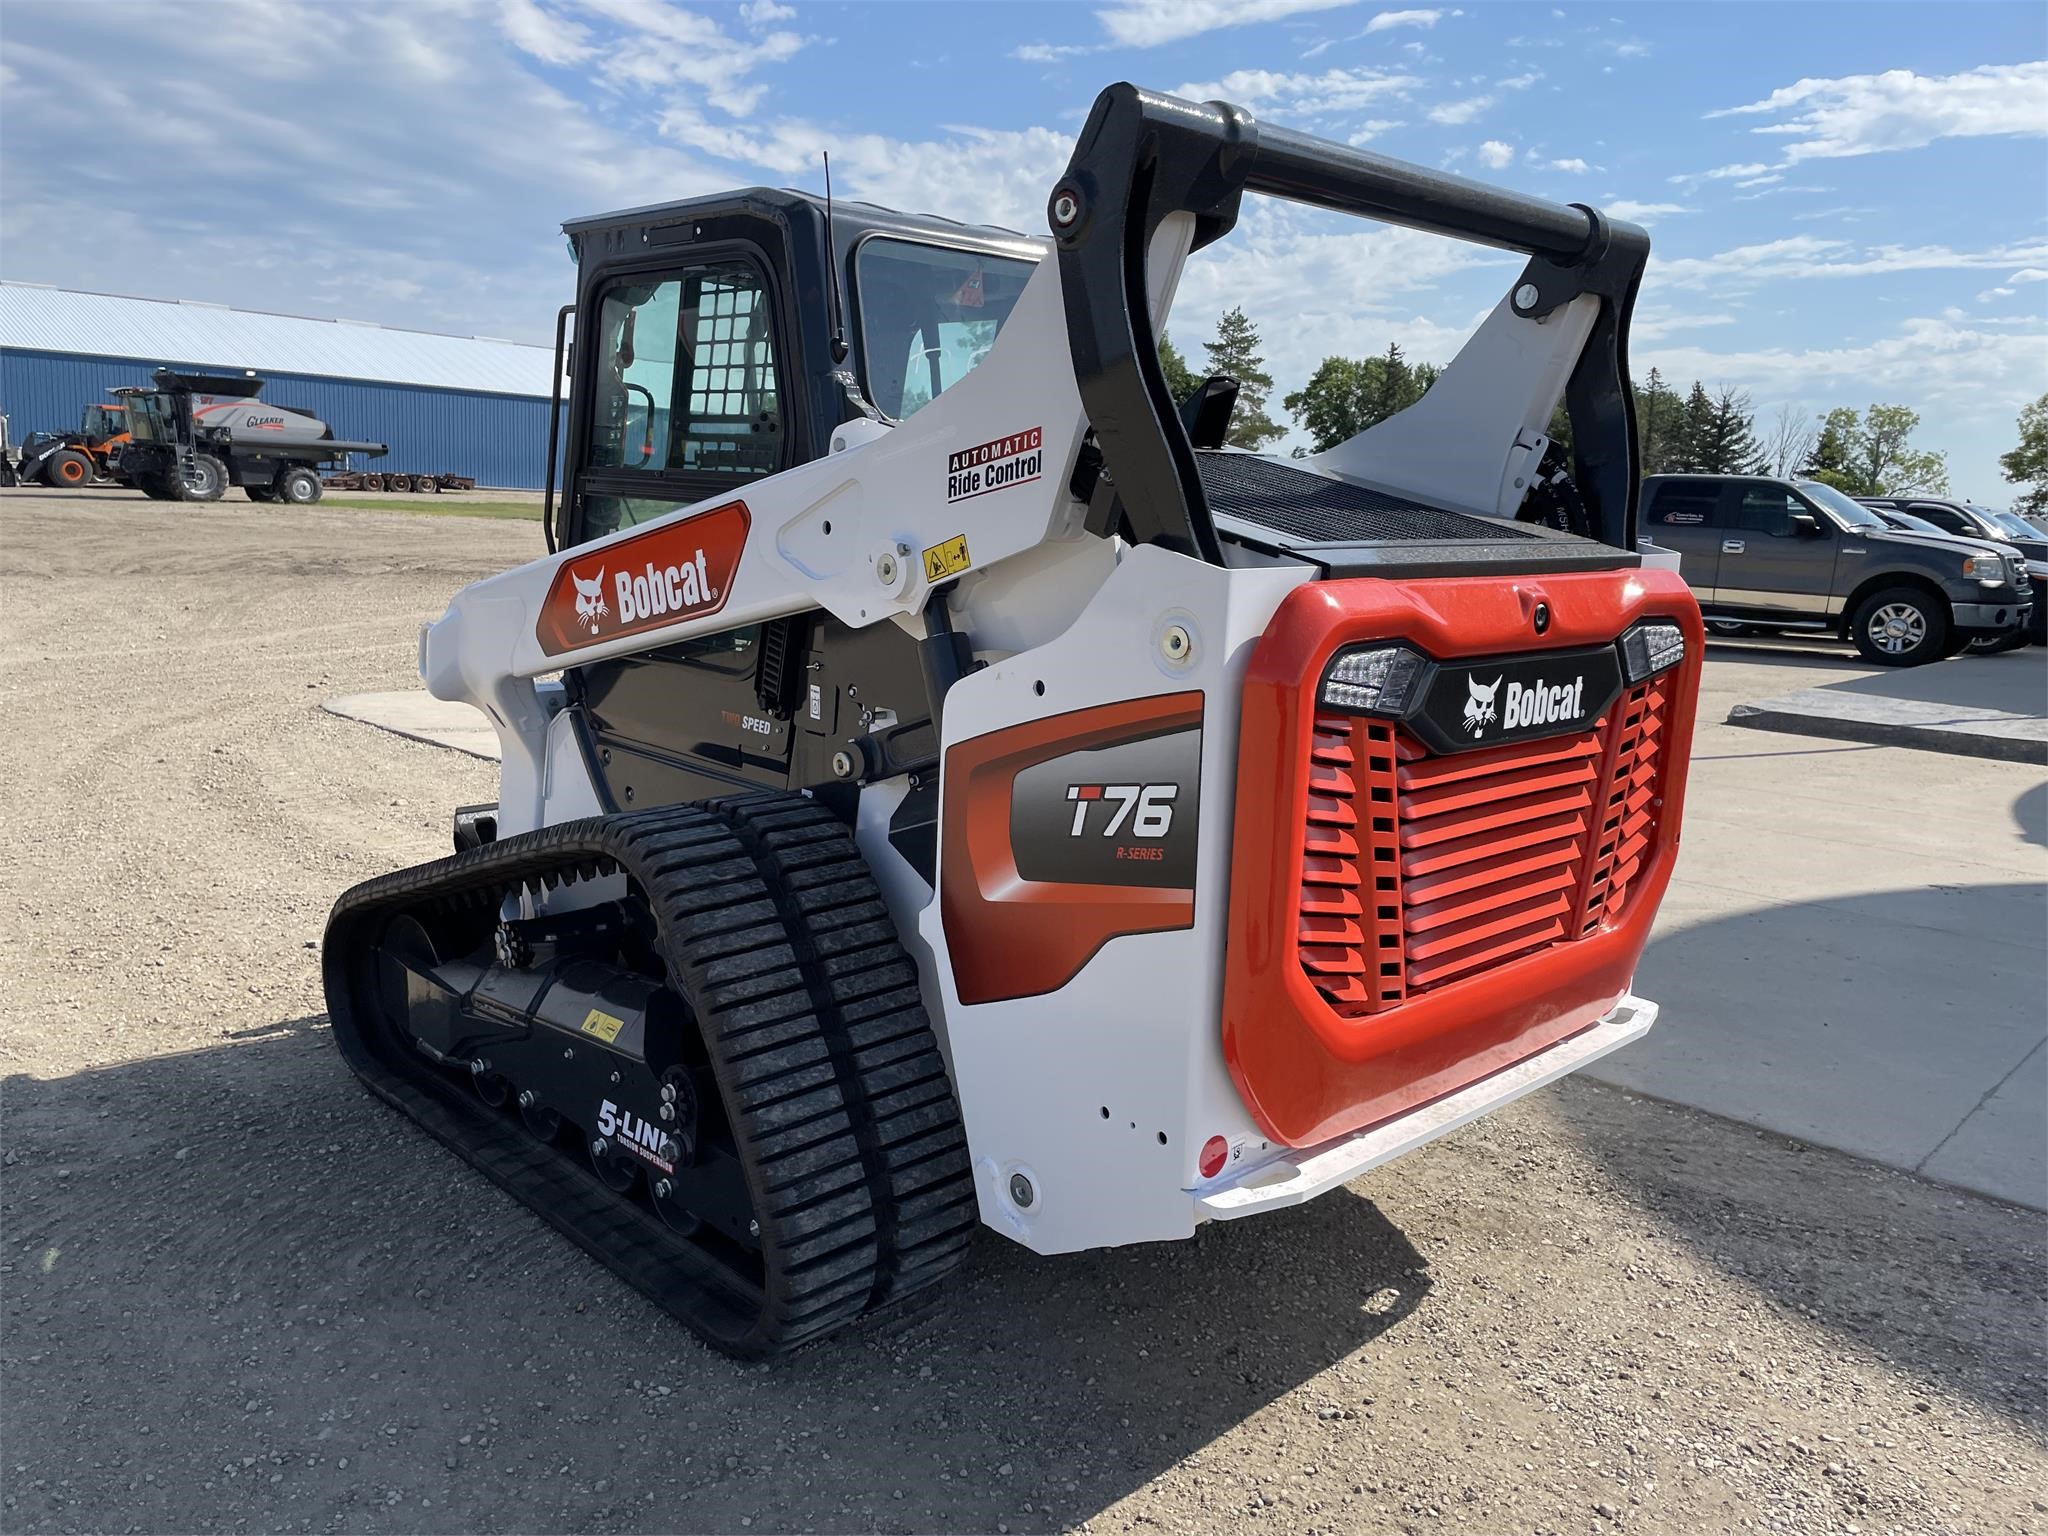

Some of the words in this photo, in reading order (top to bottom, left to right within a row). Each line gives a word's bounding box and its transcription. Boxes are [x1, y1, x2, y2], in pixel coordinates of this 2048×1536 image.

[247, 416, 284, 428] GLEANER
[952, 431, 1038, 471] AUTOMATIC
[948, 471, 980, 498] Ride
[985, 450, 1041, 487] Control
[614, 549, 711, 624] Bobcat
[1503, 675, 1583, 730] Bobcat
[742, 715, 771, 735] SPEED
[1067, 785, 1178, 838] T76
[1116, 847, 1164, 861] R-SERIES
